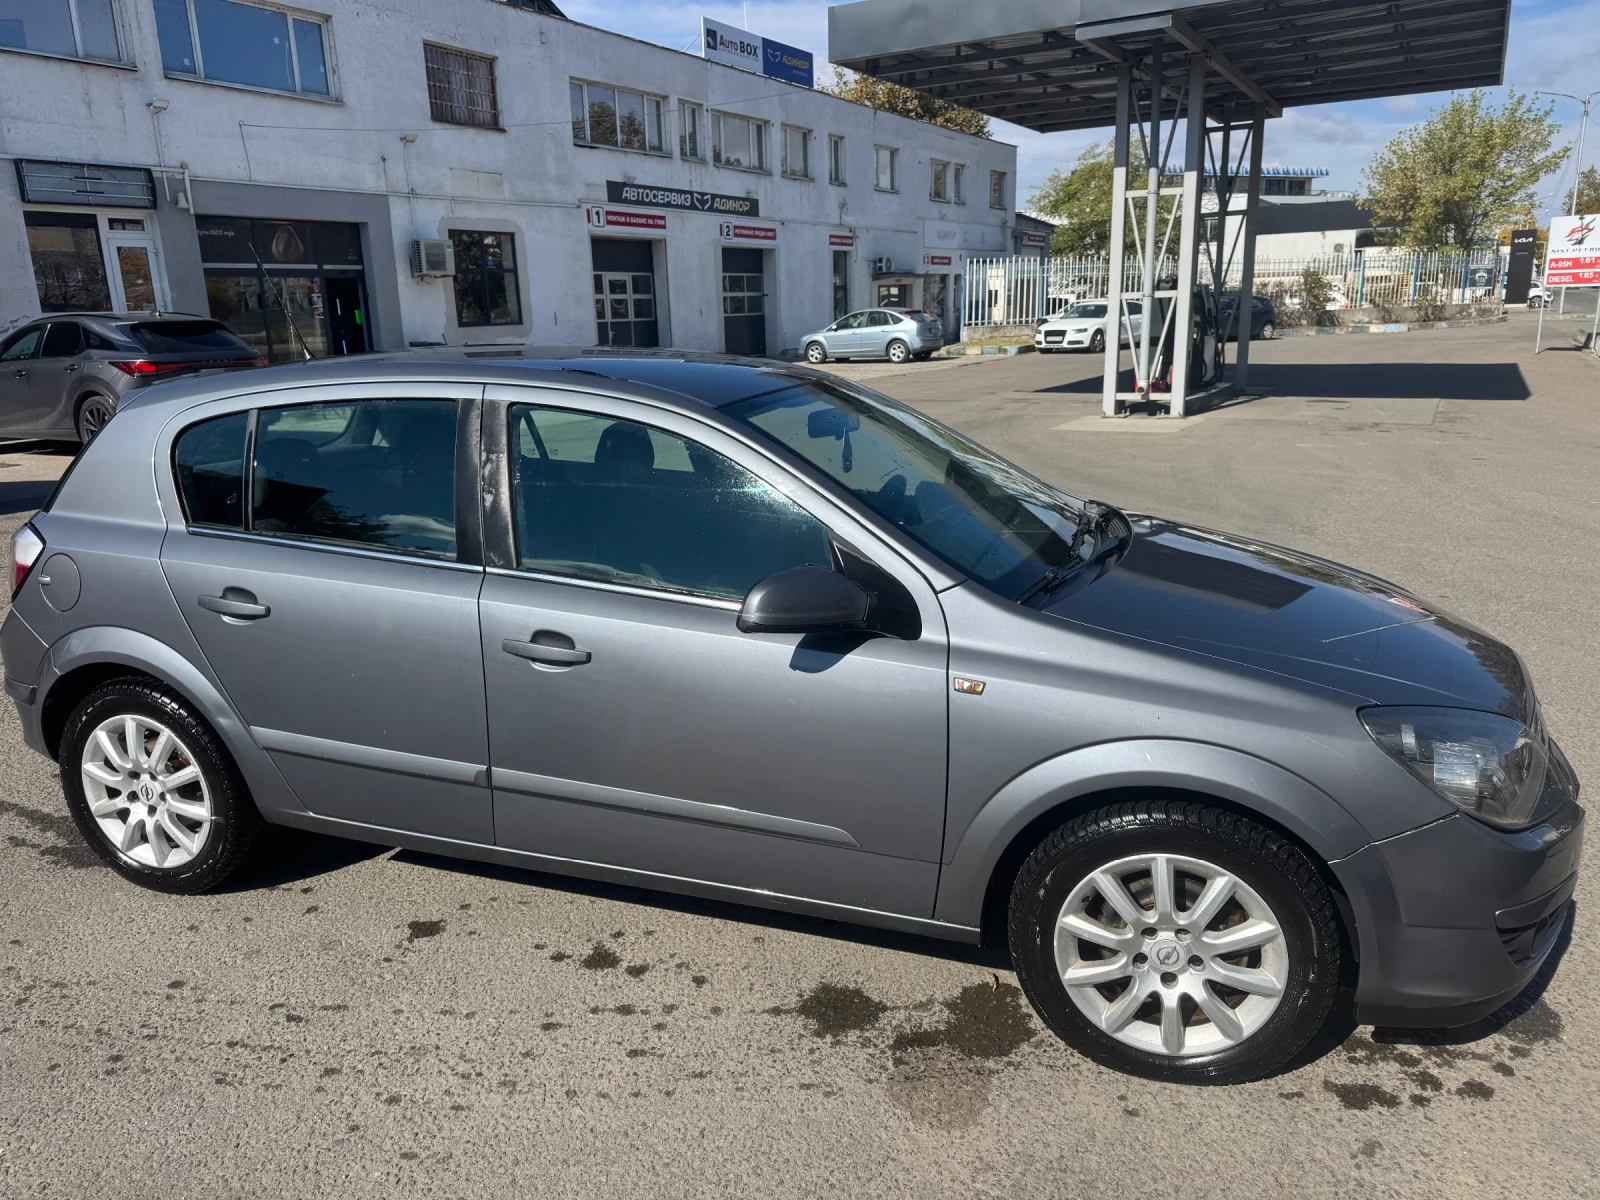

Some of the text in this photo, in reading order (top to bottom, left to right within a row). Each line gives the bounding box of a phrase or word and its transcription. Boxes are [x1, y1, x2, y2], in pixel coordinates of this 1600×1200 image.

[740, 40, 758, 58] BOX
[782, 55, 810, 70] АДИНОР
[622, 187, 750, 212] АВТОСЕРВИЗ АДИНОР
[595, 210, 600, 224] 1
[725, 224, 730, 236] 2
